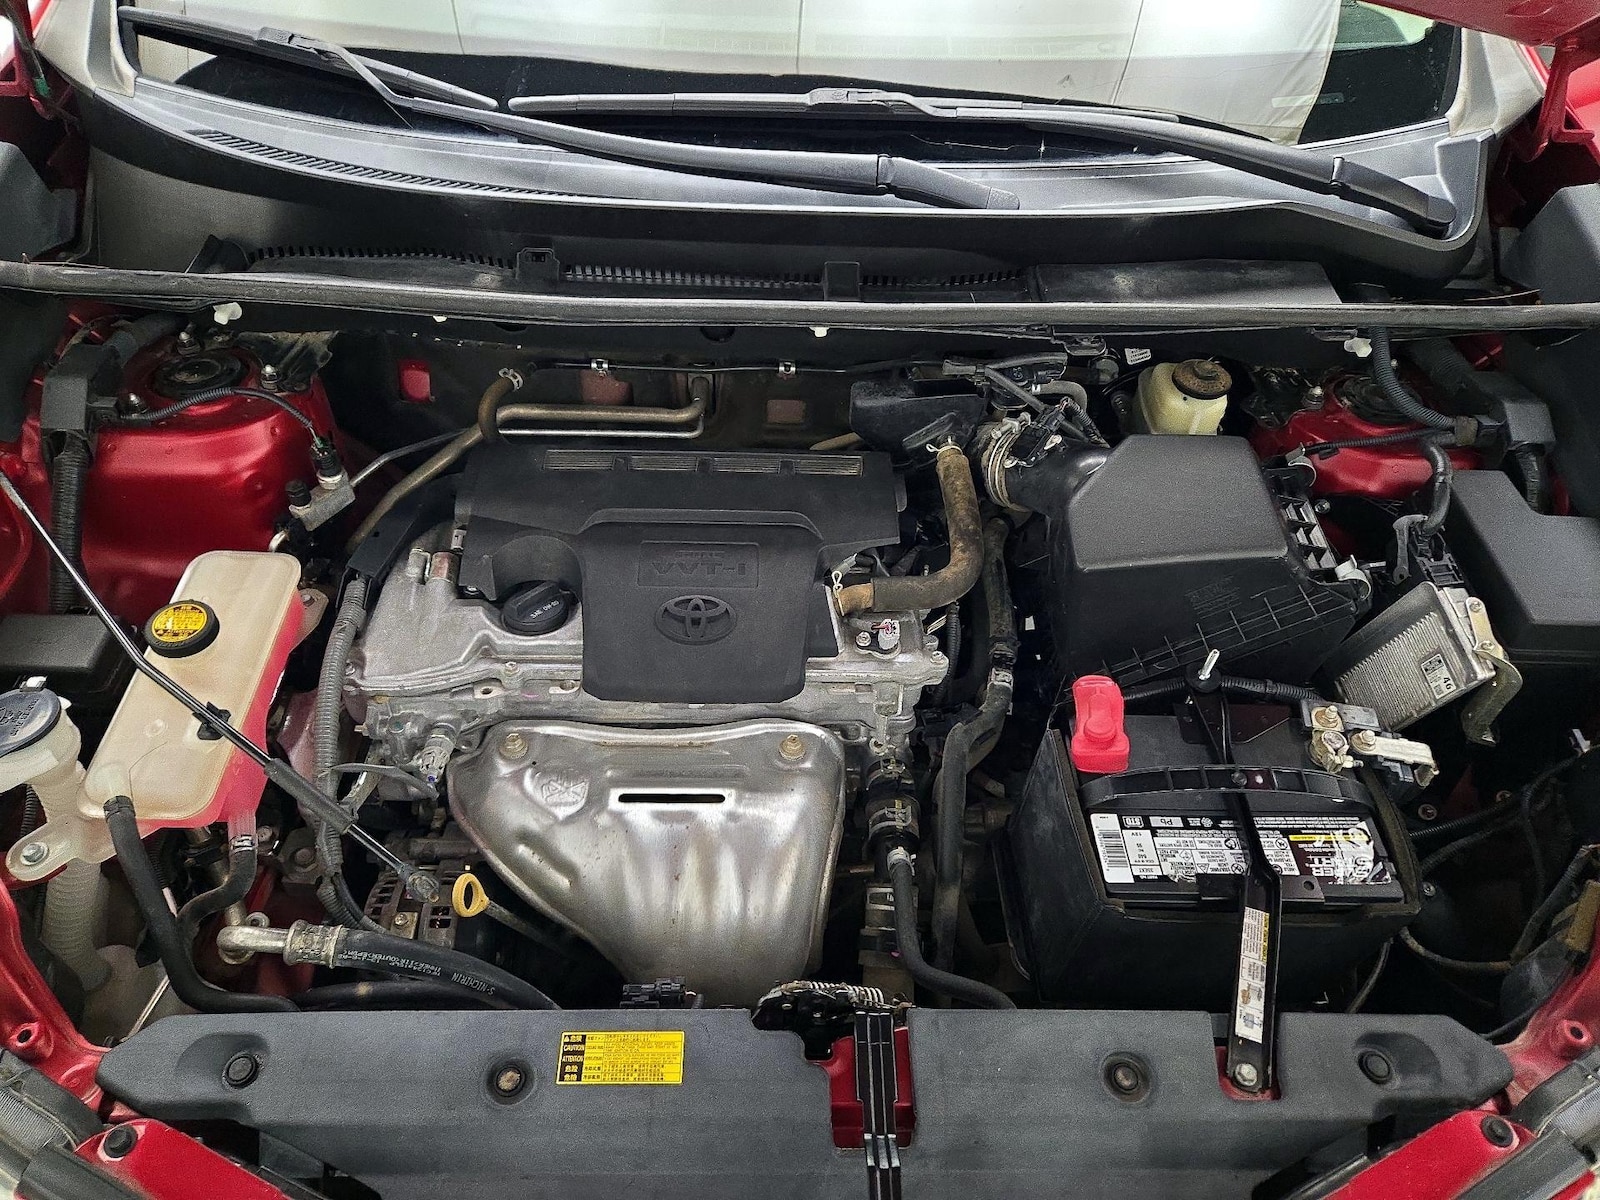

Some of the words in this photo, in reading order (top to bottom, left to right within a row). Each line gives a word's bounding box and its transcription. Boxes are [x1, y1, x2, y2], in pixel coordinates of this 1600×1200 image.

[529, 610, 544, 619] SAE
[1443, 677, 1452, 690] 46
[1160, 818, 1174, 826] Pb
